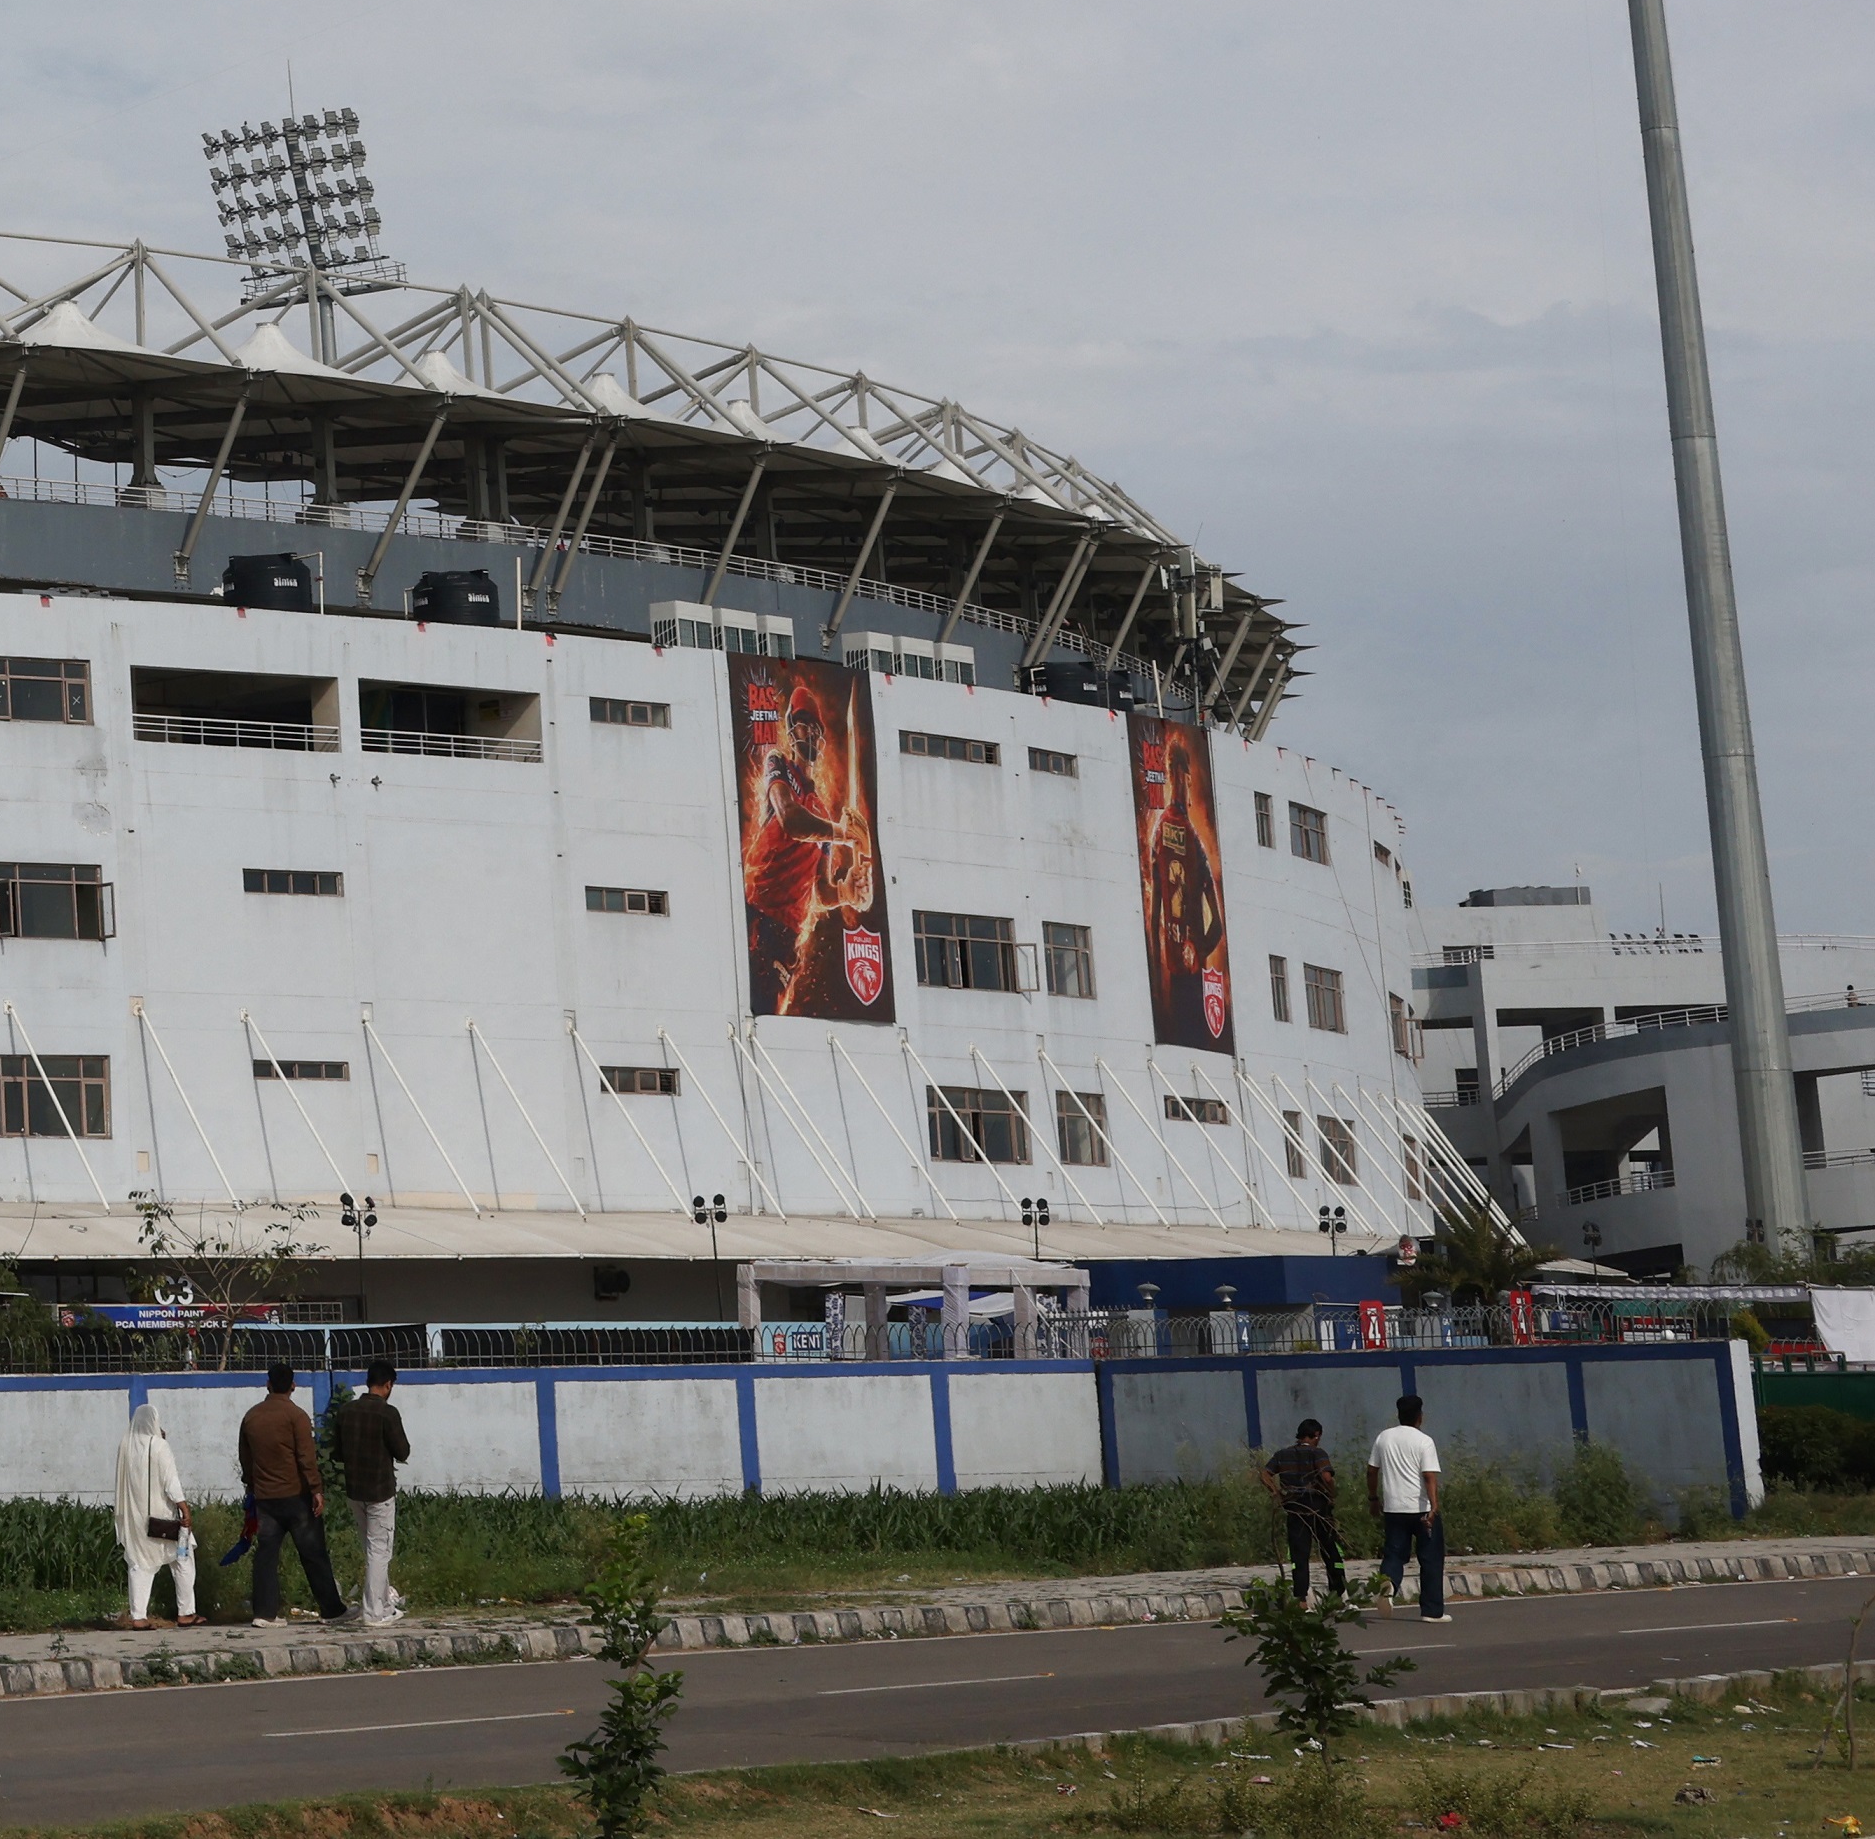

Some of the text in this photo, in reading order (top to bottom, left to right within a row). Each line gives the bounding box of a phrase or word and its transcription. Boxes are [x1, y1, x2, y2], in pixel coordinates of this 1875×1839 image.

[847, 942, 880, 964] KINGS
[138, 1309, 205, 1319] NIPPON PAINT
[115, 1320, 136, 1329] PCA
[137, 1320, 185, 1329] MEMBERS
[793, 1334, 821, 1349] KENT
